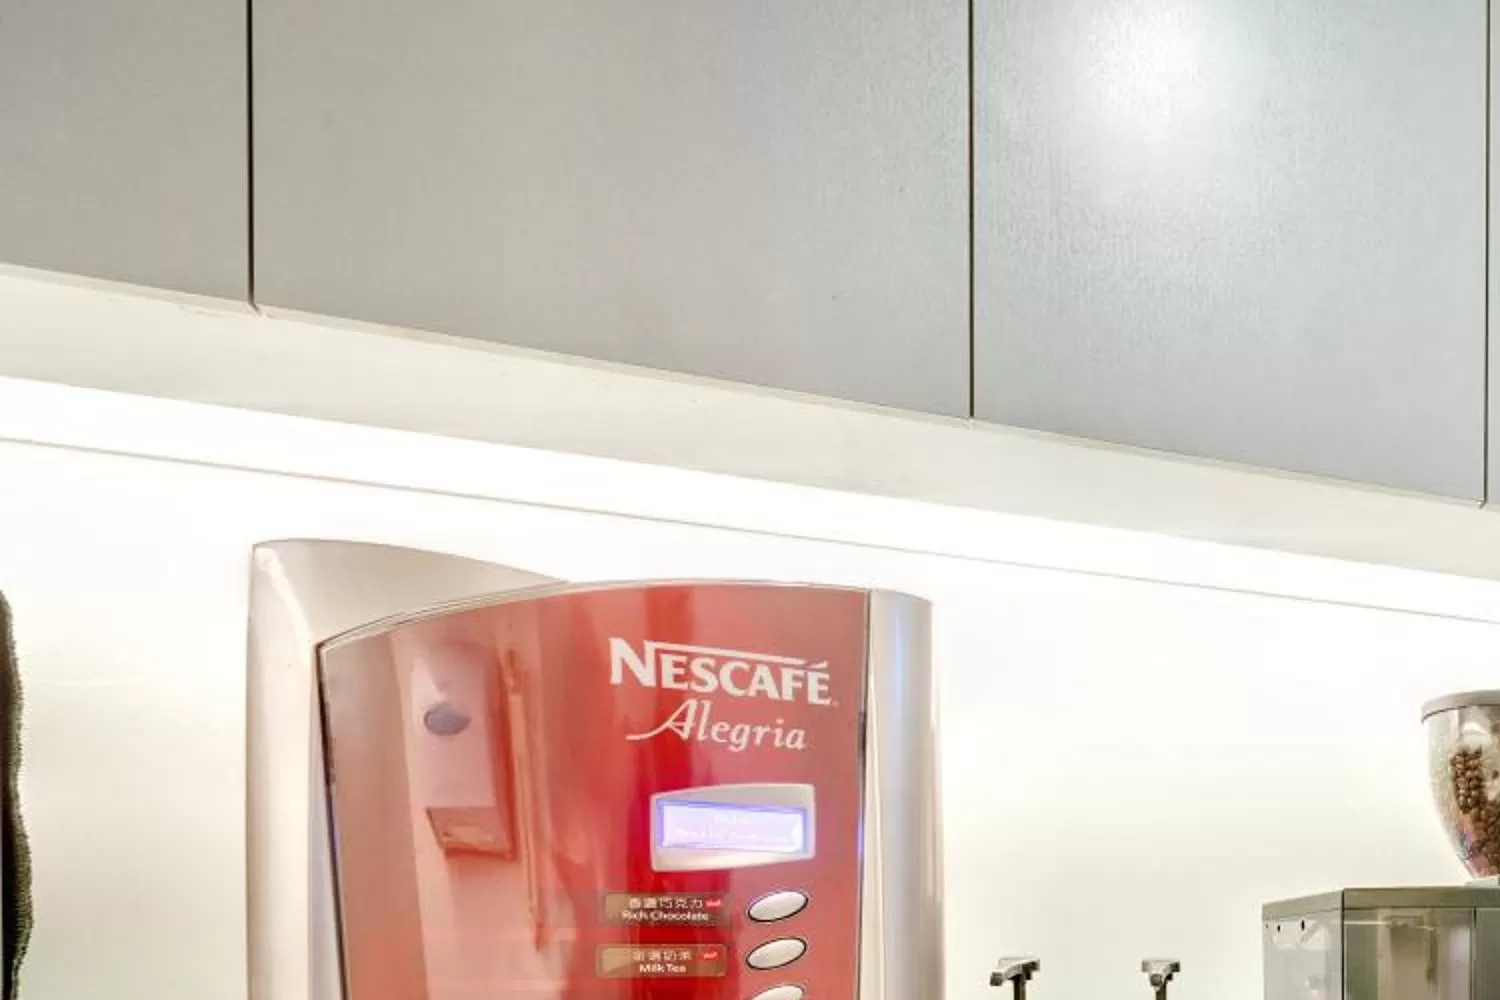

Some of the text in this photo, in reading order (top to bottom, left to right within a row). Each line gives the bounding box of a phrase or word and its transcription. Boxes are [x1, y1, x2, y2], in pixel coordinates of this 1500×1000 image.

[608, 636, 832, 706] NESCAFÉ
[625, 698, 807, 753] Alegria
[621, 910, 709, 921] Rich Chocolate
[639, 963, 687, 973] Milk Tea
